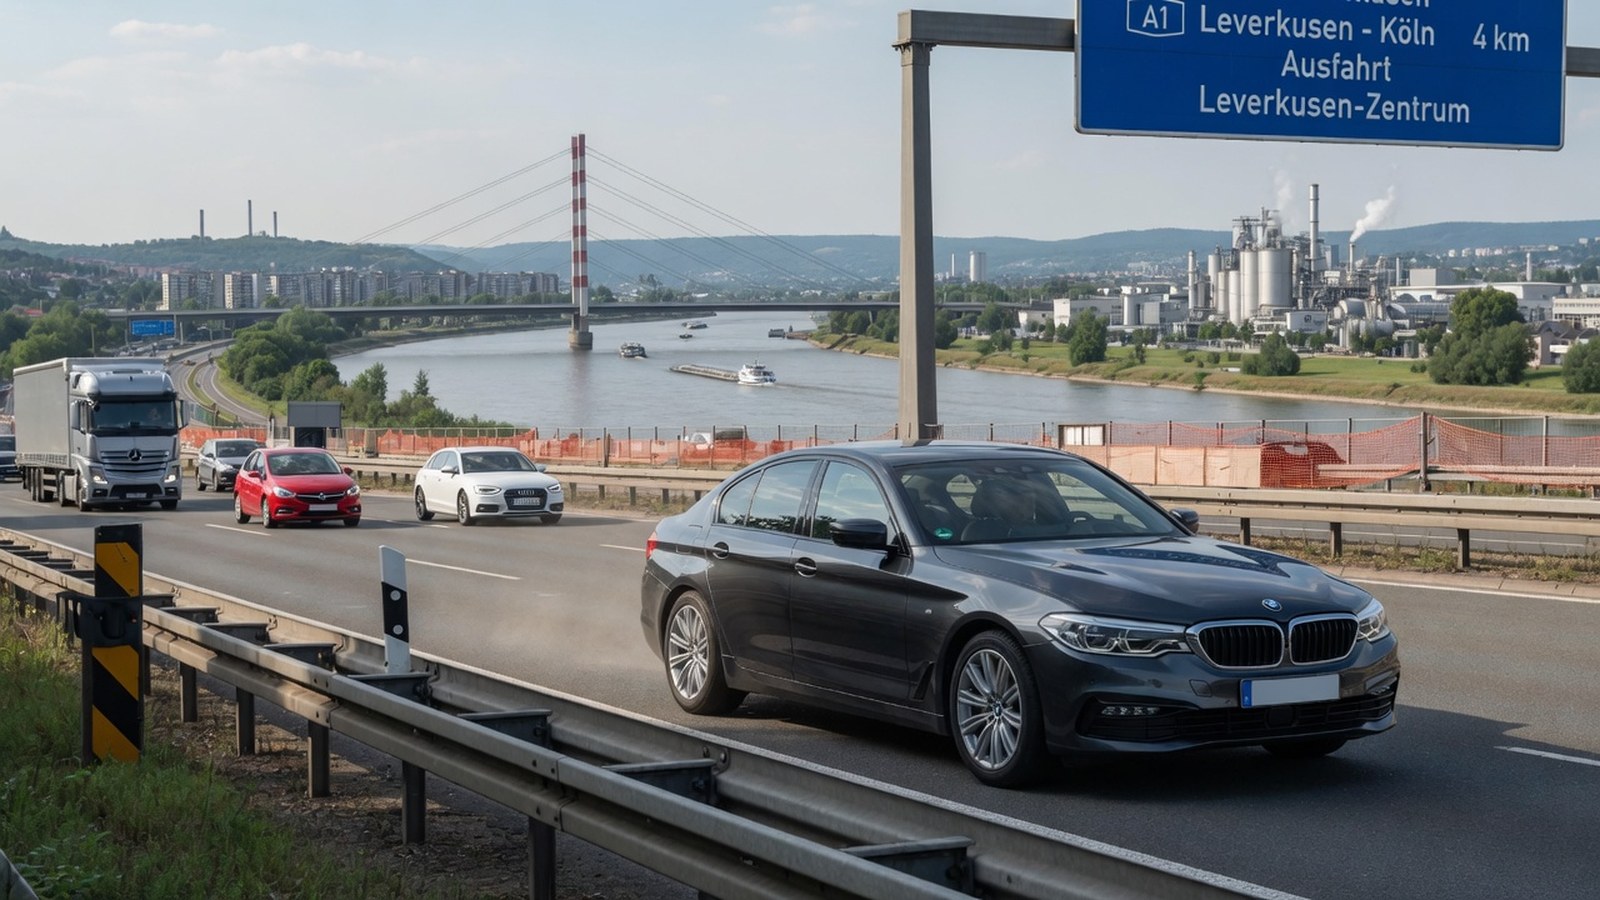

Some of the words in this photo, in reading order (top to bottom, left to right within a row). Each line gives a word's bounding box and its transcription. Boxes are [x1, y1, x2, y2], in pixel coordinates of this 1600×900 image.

[1142, 5, 1167, 29] A1
[1201, 4, 1353, 42] Leverkusen
[1380, 15, 1435, 46] Köln
[1473, 23, 1487, 49] 4
[1494, 24, 1529, 52] km
[1281, 49, 1391, 82] Ausfahrt
[1200, 84, 1470, 123] Leverkusen-Zentrum
